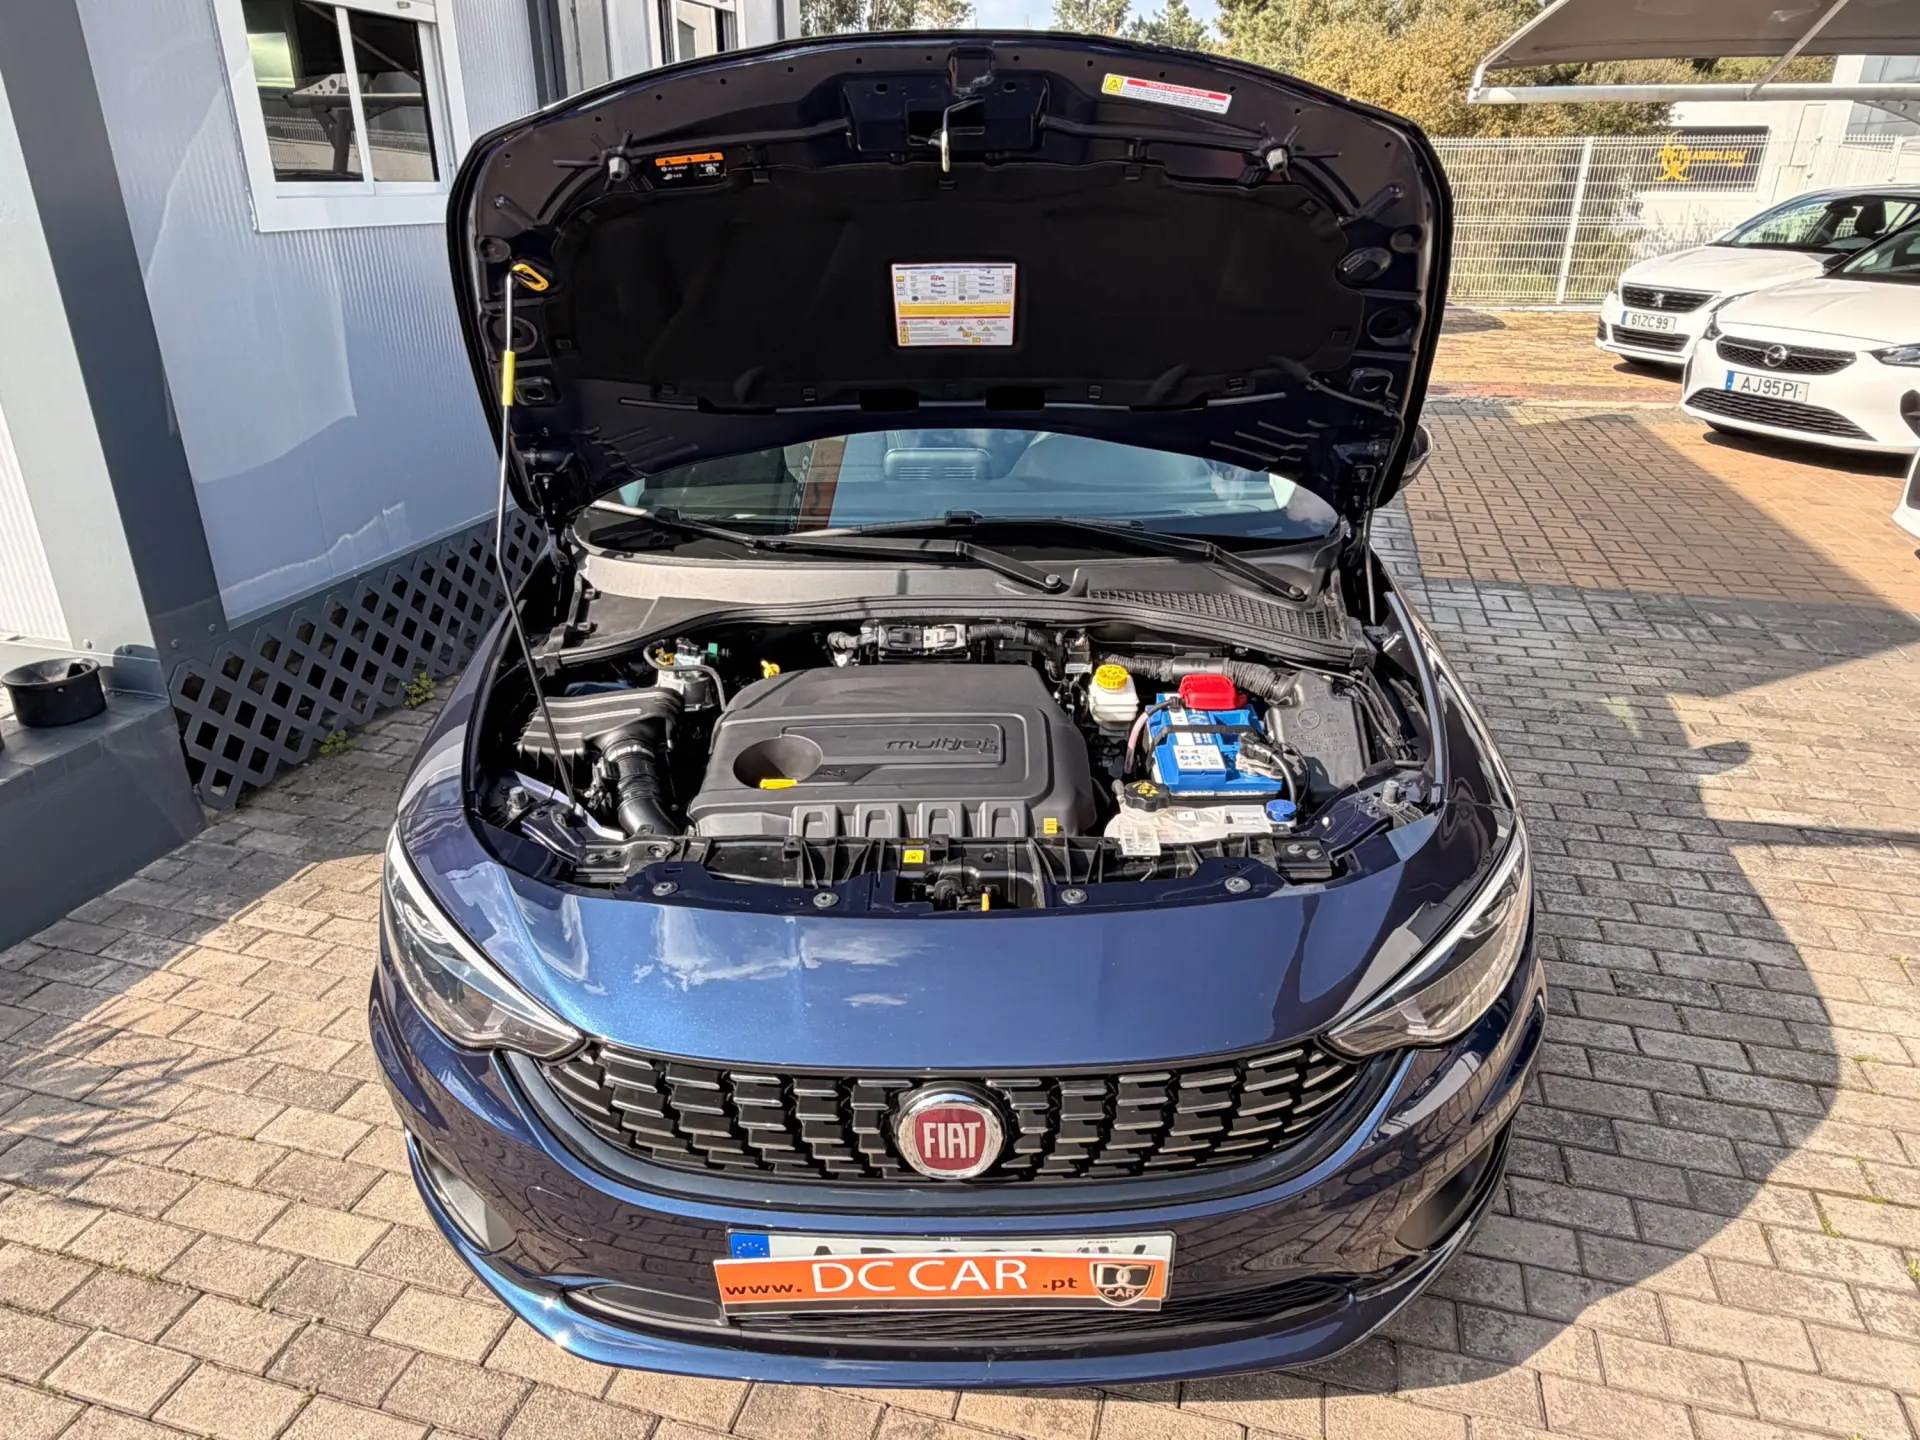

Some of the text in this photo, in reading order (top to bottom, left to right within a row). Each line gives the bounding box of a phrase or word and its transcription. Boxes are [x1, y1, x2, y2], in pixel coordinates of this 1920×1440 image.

[1631, 314, 1669, 330] 61ZC99
[1741, 376, 1798, 399] AJ95PI
[922, 1121, 981, 1159] FIAT
[725, 1259, 1078, 1296] www. DC CAR .pt
[1103, 1288, 1136, 1298] CAR
